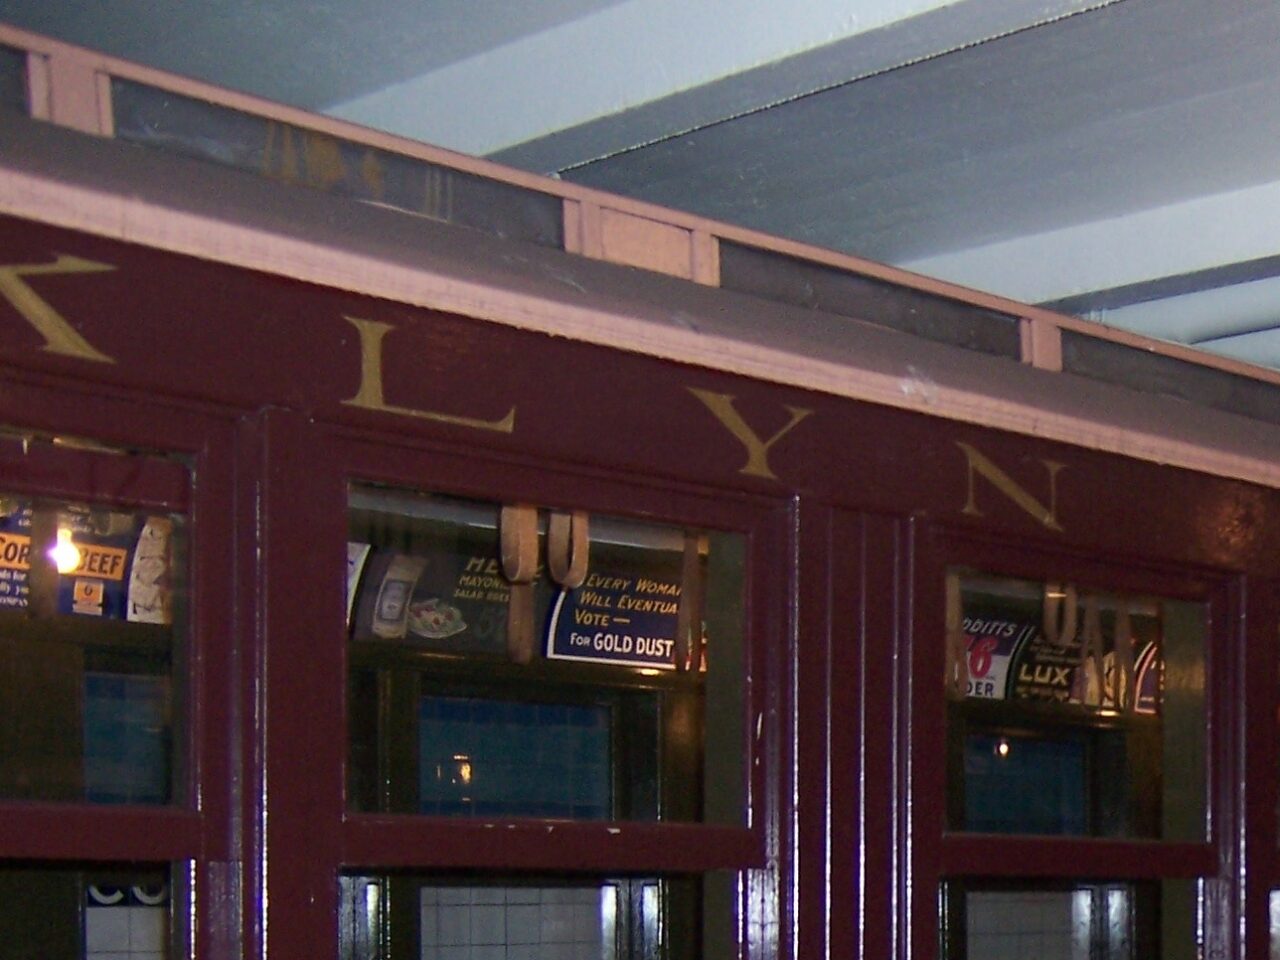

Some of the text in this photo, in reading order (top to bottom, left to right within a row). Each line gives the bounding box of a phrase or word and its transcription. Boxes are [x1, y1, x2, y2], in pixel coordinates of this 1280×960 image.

[587, 573, 632, 589] EVERY
[580, 590, 679, 615] WILL EVENTUA
[575, 609, 610, 627] VOTE
[570, 632, 675, 658] FOR GOLD DUST
[1019, 663, 1071, 686] LUX
